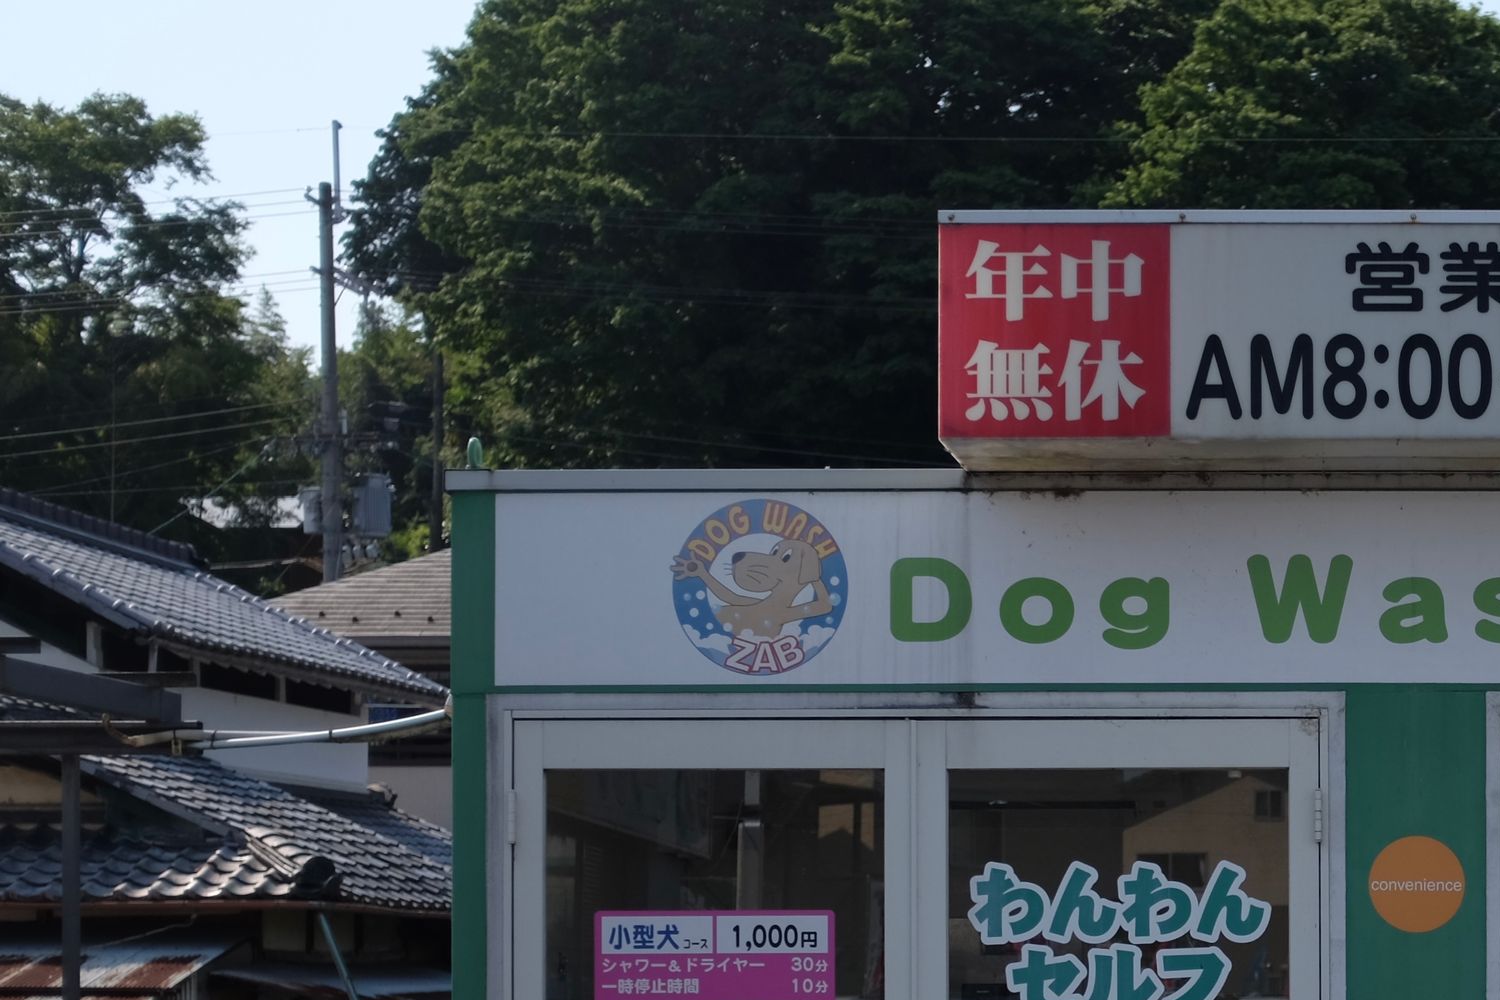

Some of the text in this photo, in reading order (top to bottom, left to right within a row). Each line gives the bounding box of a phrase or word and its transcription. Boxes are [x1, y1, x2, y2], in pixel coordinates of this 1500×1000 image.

[964, 240, 1142, 323] 年中
[964, 339, 1145, 423] 無休
[688, 501, 838, 561] DOG WASH
[890, 556, 1170, 650] Dog
[725, 635, 805, 674] ZAB
[967, 860, 1271, 943] わんわん
[1371, 879, 1462, 891] convenience
[732, 924, 818, 950] 1,000円
[601, 978, 829, 994] 一時停止時間 10分
[602, 957, 829, 973] シャワー&ドライヤー 30分
